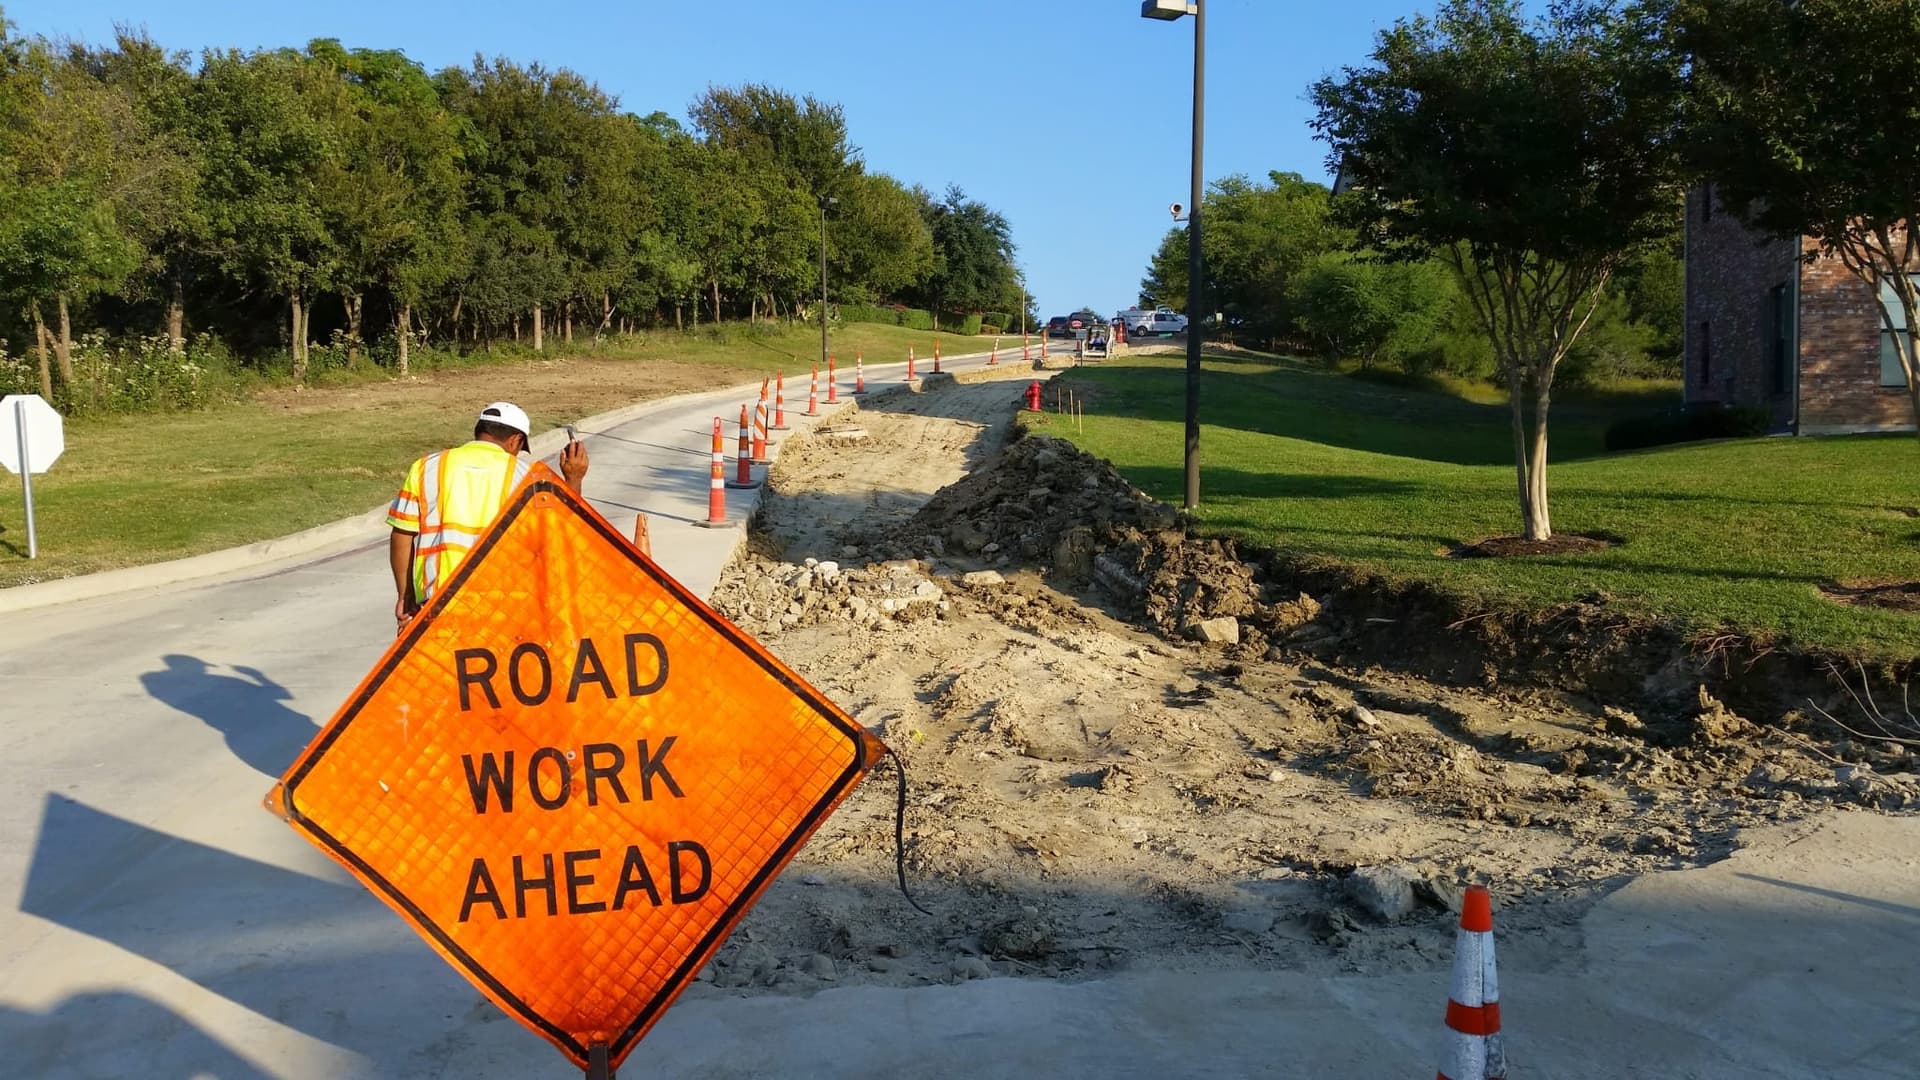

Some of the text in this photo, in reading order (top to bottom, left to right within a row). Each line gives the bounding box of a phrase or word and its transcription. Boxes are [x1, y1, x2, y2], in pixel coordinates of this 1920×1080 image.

[454, 633, 669, 711] ROAD
[461, 736, 685, 814] WORK
[458, 840, 712, 922] AHEAD
